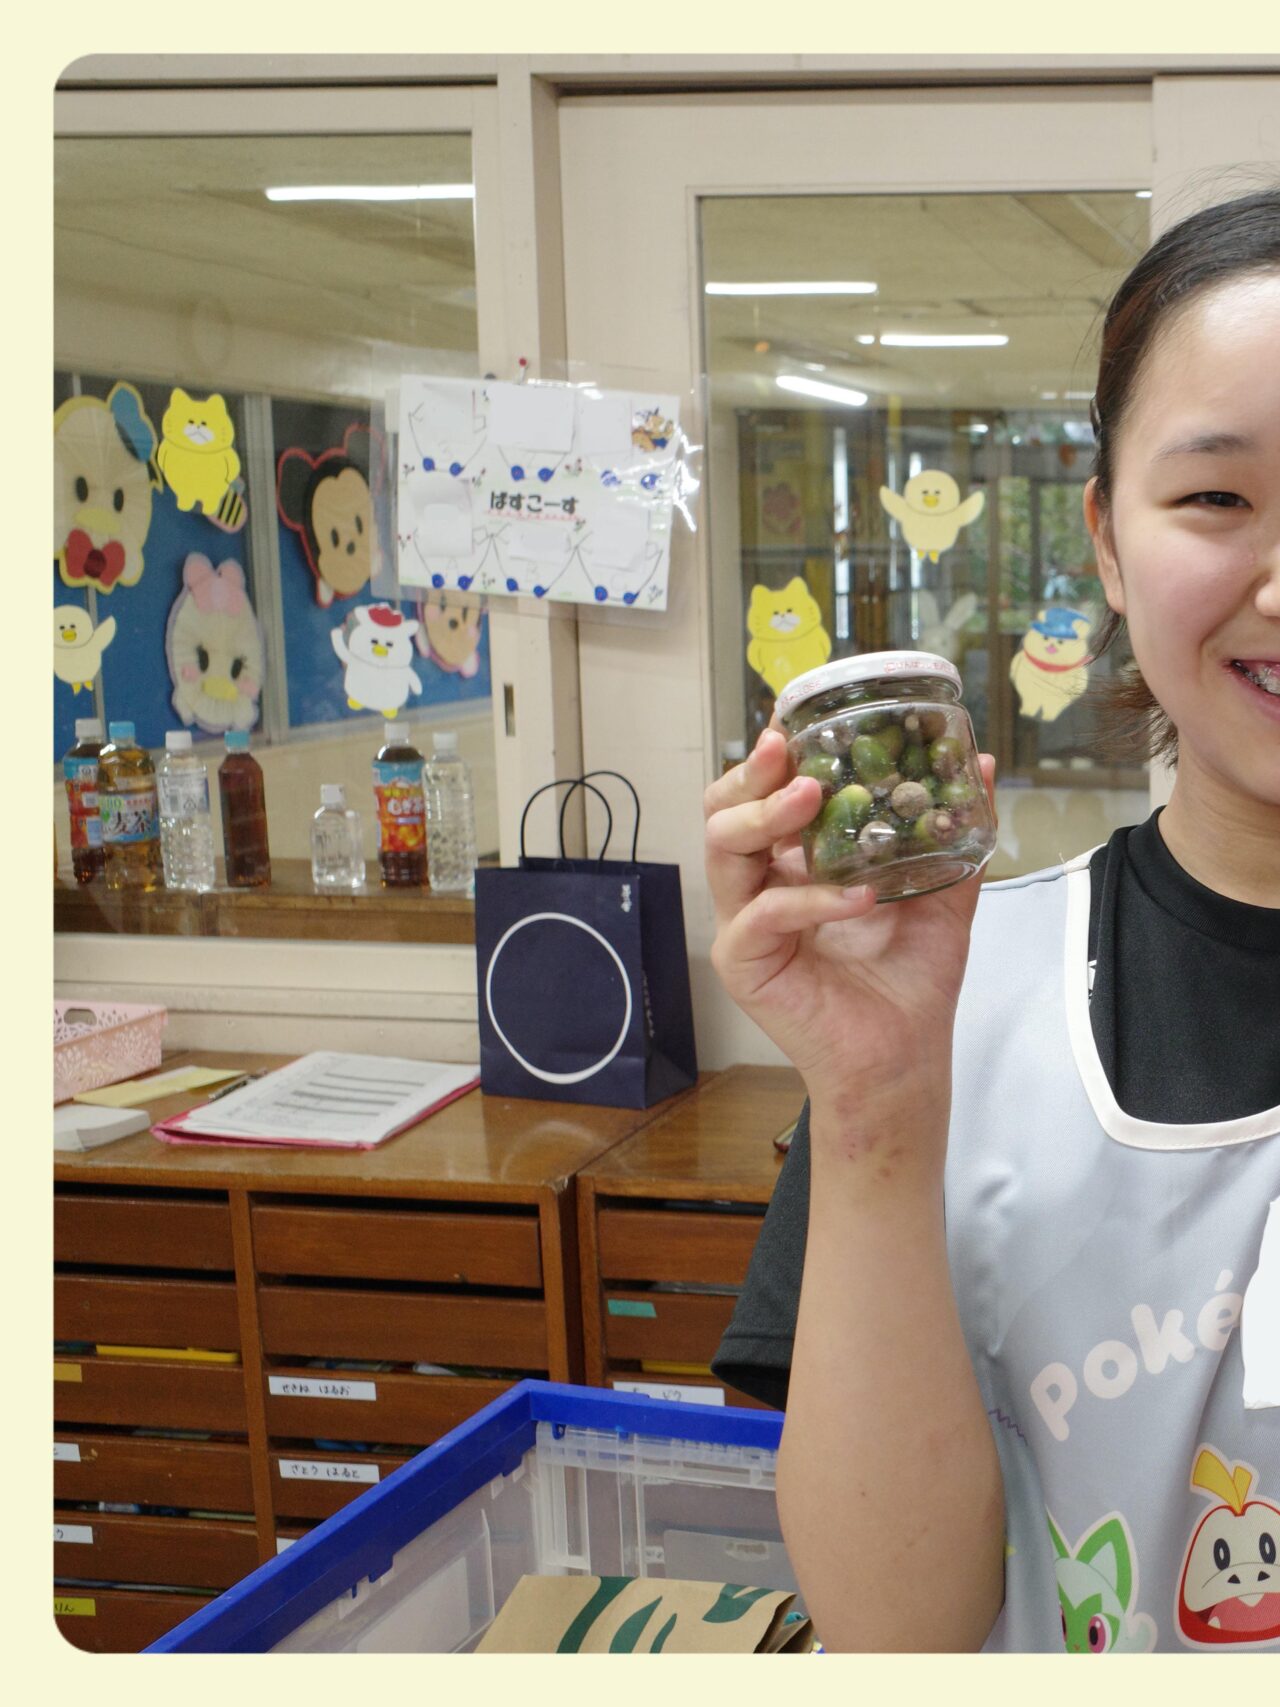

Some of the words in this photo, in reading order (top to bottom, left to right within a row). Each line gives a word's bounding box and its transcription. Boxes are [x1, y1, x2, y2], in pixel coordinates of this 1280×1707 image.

[489, 490, 579, 515] ばすこーす
